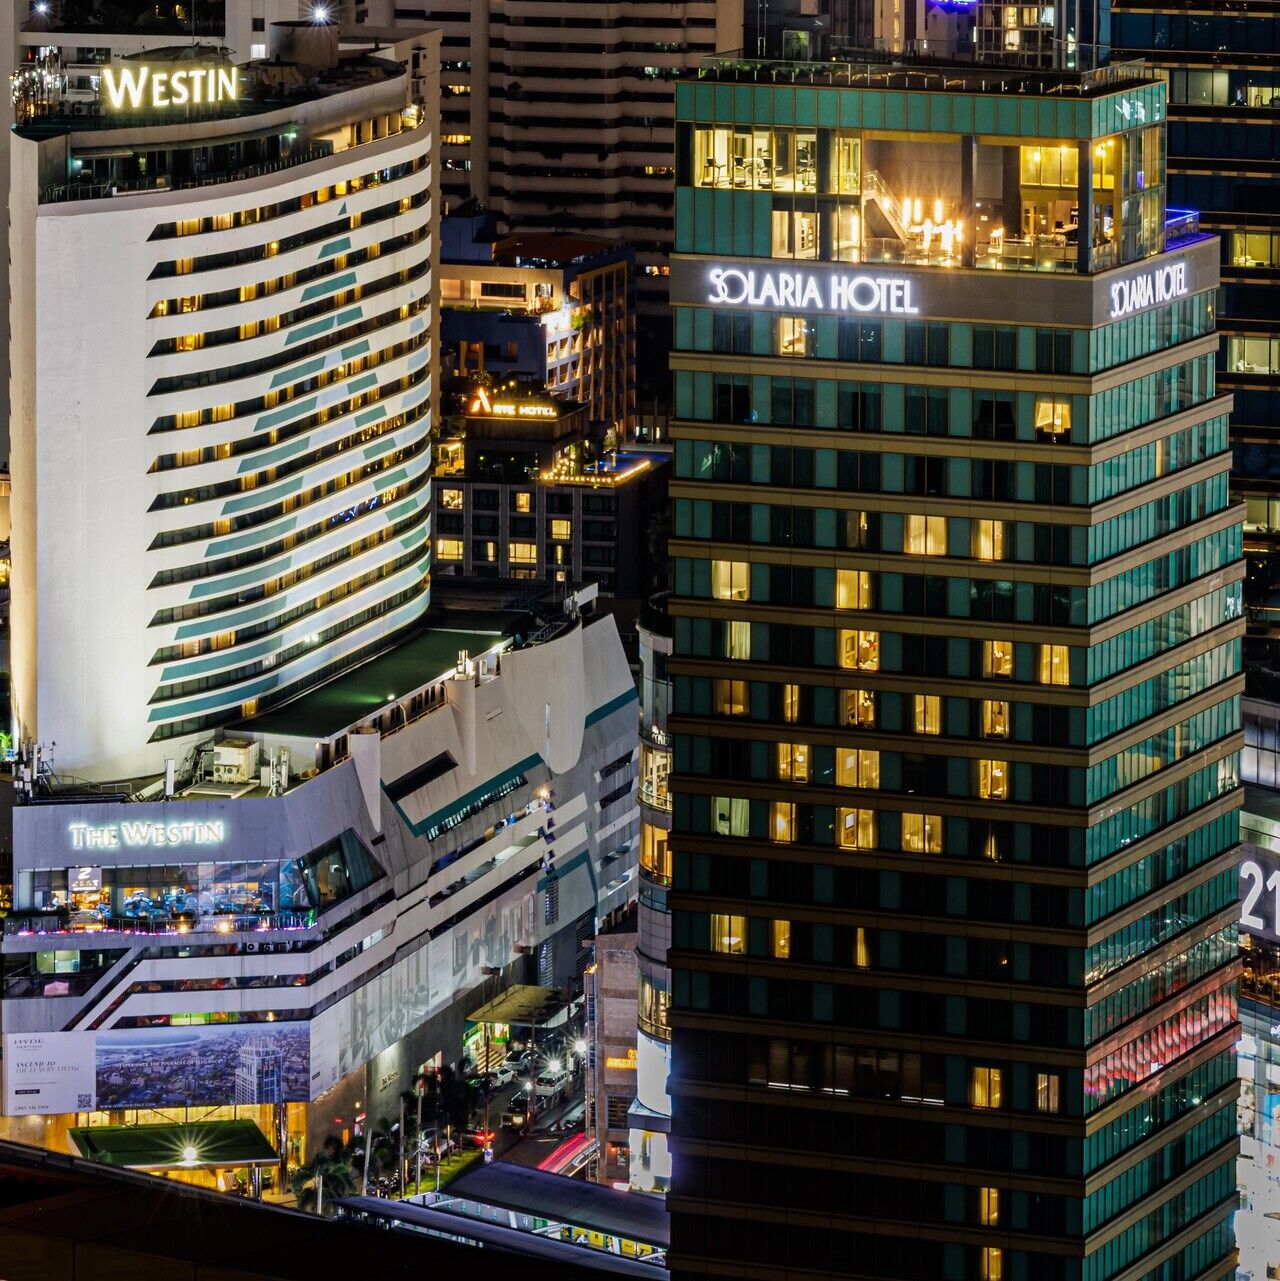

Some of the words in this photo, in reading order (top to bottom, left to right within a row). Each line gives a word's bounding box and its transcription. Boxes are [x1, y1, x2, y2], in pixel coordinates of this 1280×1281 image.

[102, 66, 239, 109] WESTIN
[708, 268, 823, 308] SOLARIA
[831, 274, 919, 314] HOTEL
[1110, 274, 1154, 318] SOLARIA
[1155, 261, 1188, 303] HOTEL
[69, 824, 120, 849] THE
[122, 822, 224, 845] WESTIN
